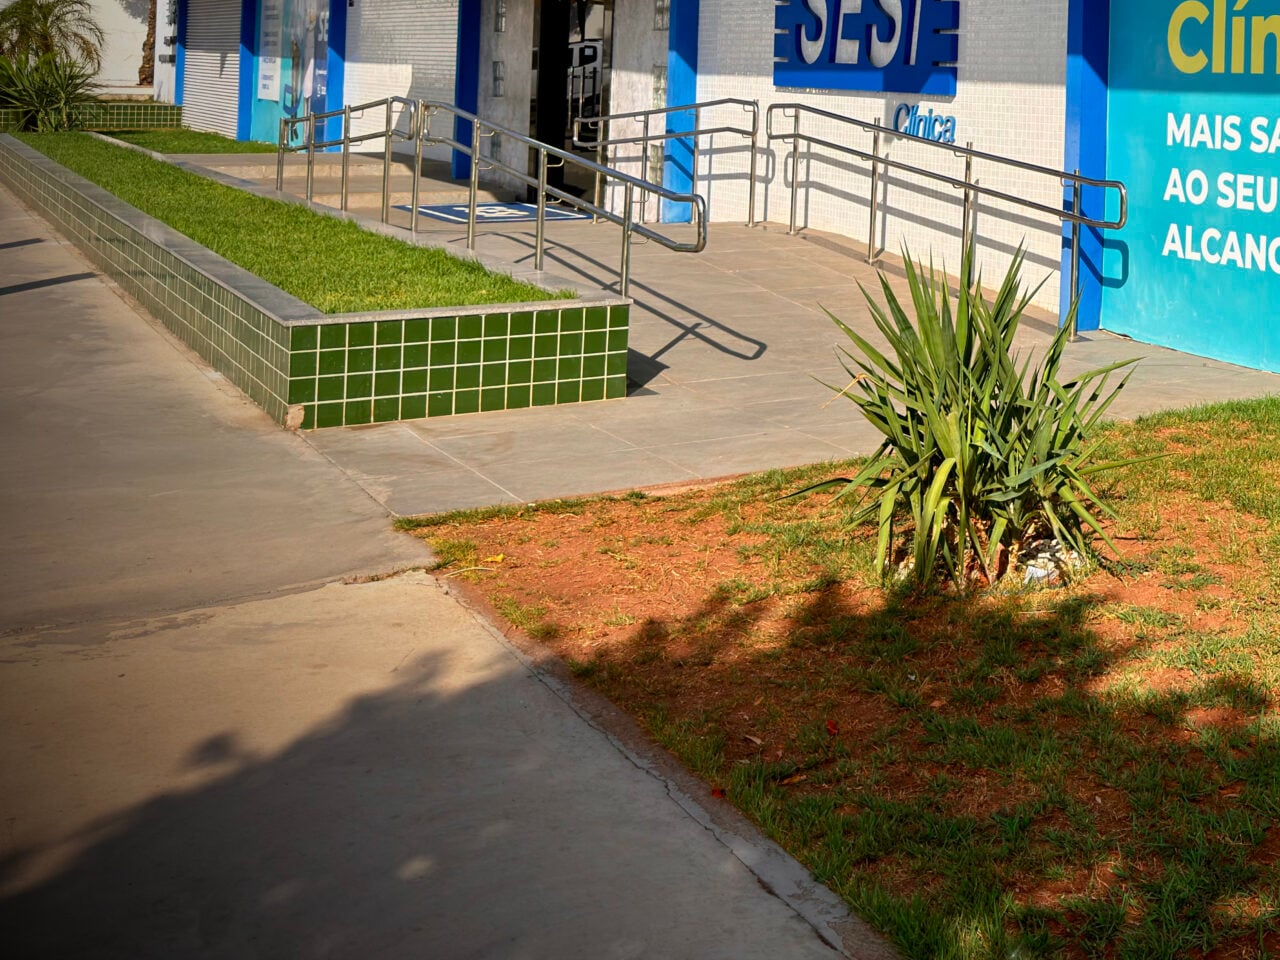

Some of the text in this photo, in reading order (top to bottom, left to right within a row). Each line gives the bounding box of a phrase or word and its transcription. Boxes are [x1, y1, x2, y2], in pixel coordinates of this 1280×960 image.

[893, 103, 956, 144] Clínica
[1167, 112, 1242, 151] MAIS
[1164, 168, 1278, 213] AO SEU
